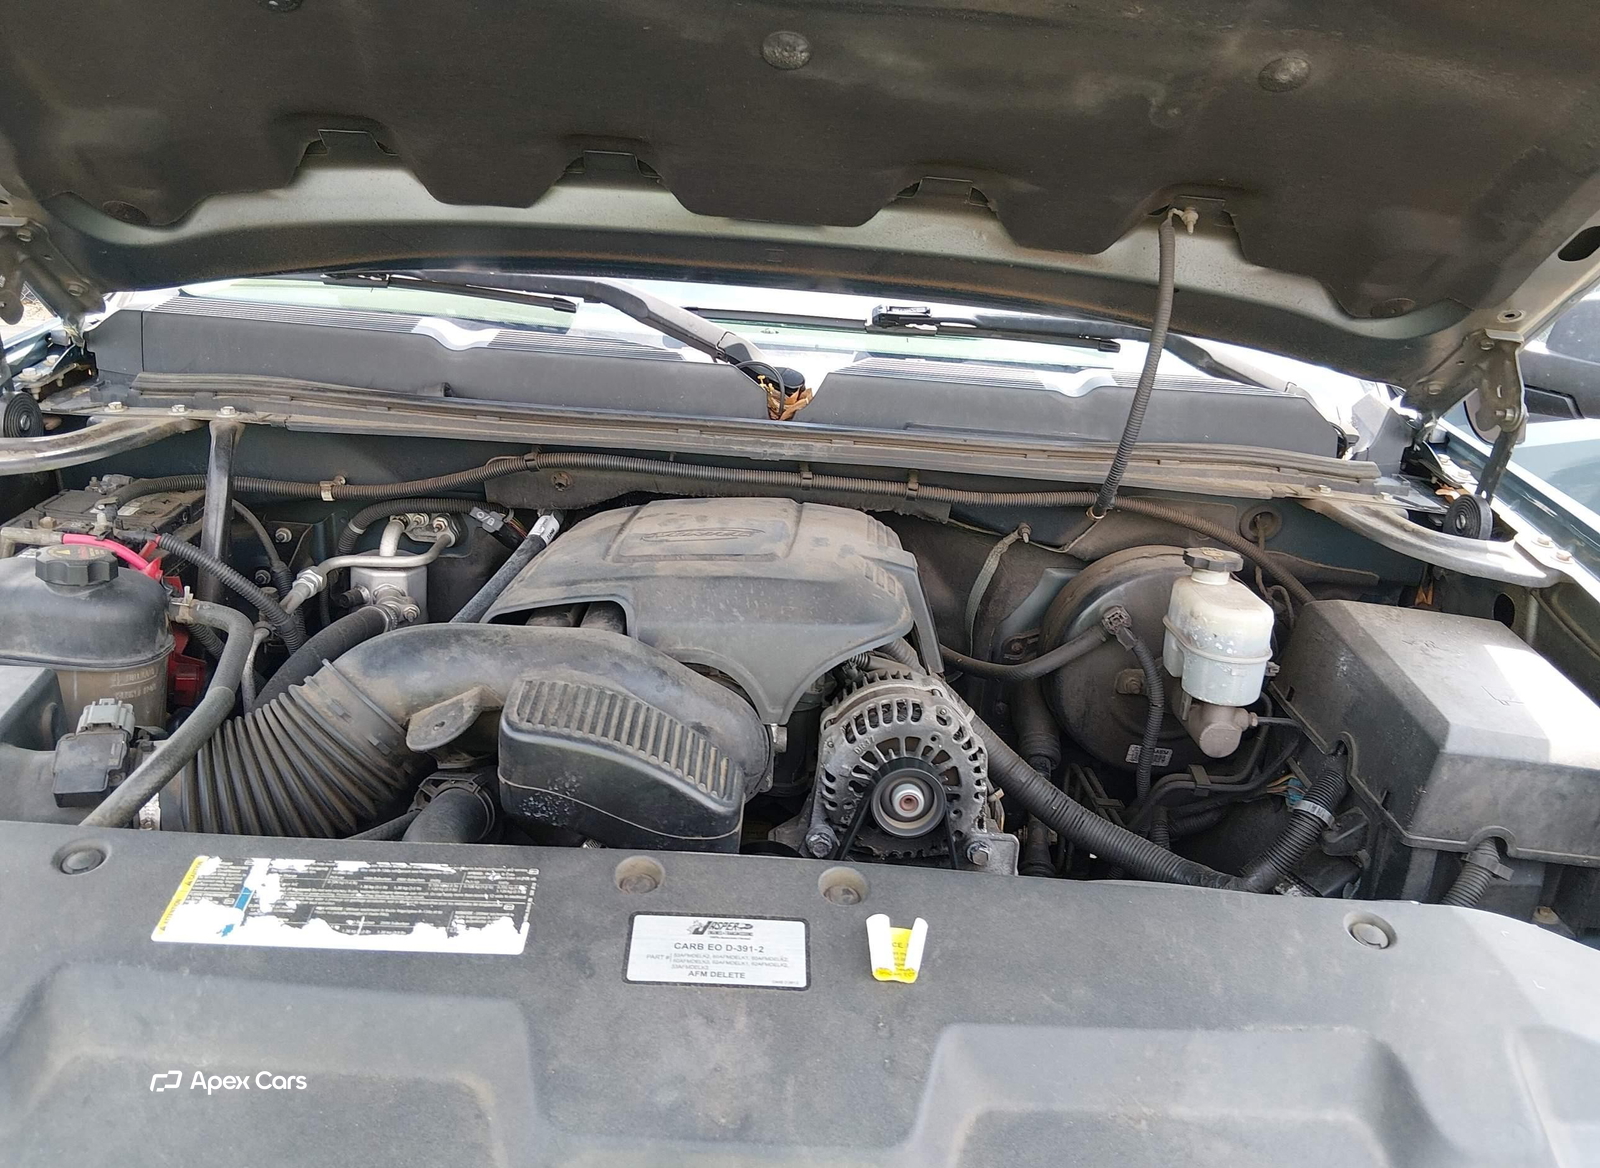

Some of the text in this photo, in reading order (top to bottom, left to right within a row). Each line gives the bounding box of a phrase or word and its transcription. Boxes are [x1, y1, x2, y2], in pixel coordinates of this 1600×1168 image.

[692, 920, 754, 936] JASPER
[673, 942, 765, 954] CARB EO D-391-2
[687, 970, 746, 980] AFM DELETE
